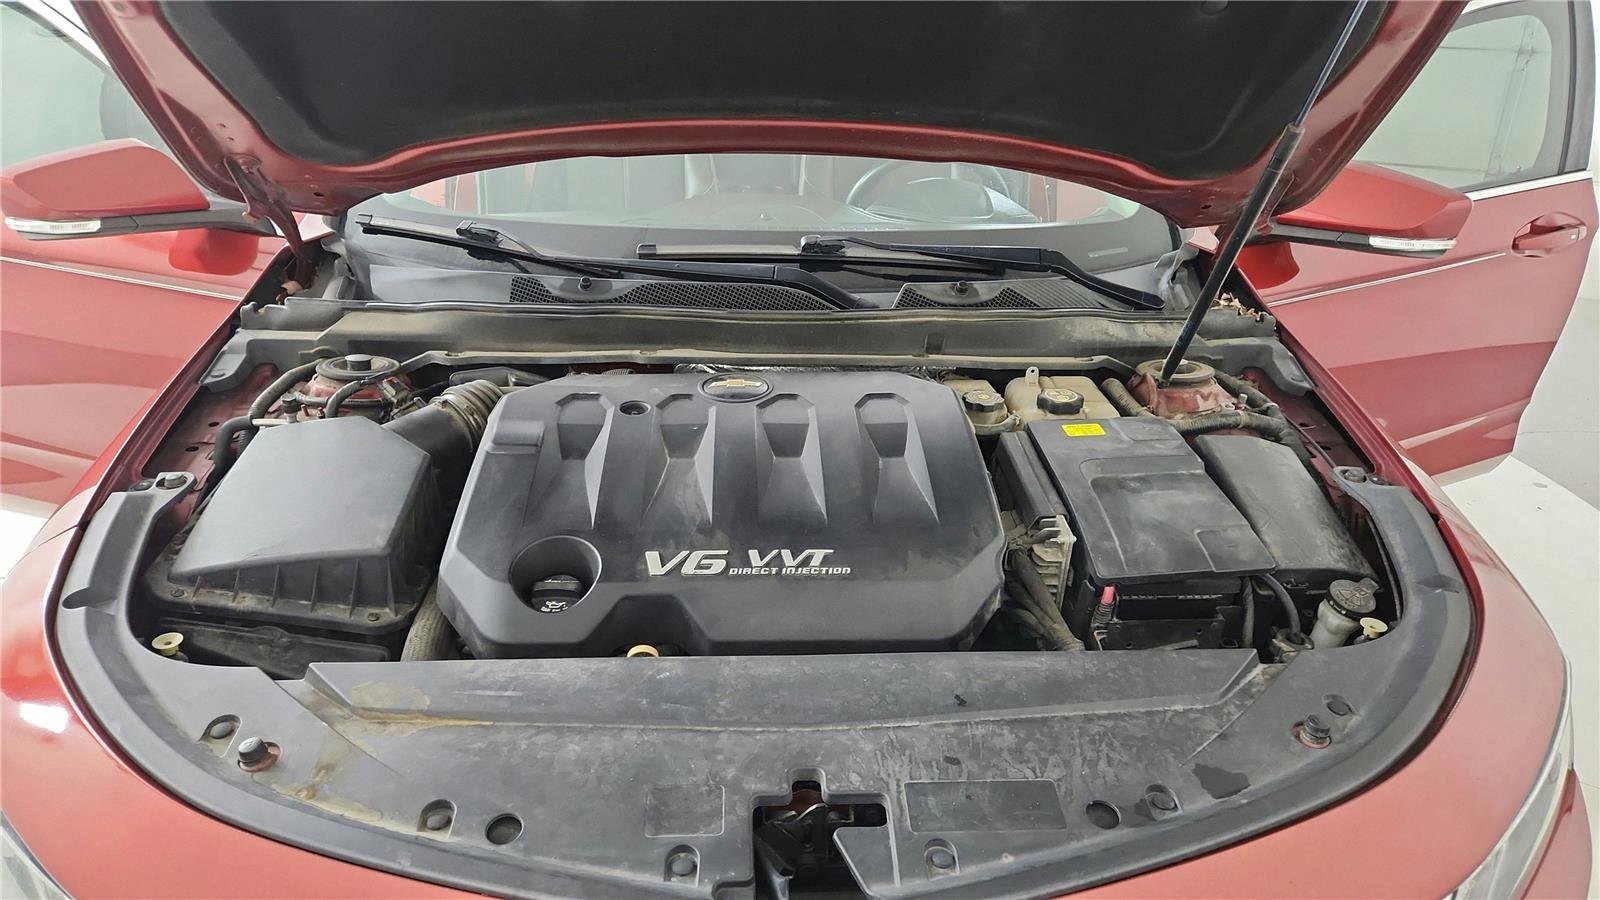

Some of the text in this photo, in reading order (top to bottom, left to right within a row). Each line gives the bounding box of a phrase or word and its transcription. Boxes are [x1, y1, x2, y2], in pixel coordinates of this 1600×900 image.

[645, 549, 834, 576] V6 VVT
[729, 567, 851, 575] DIRECT INJECTION
